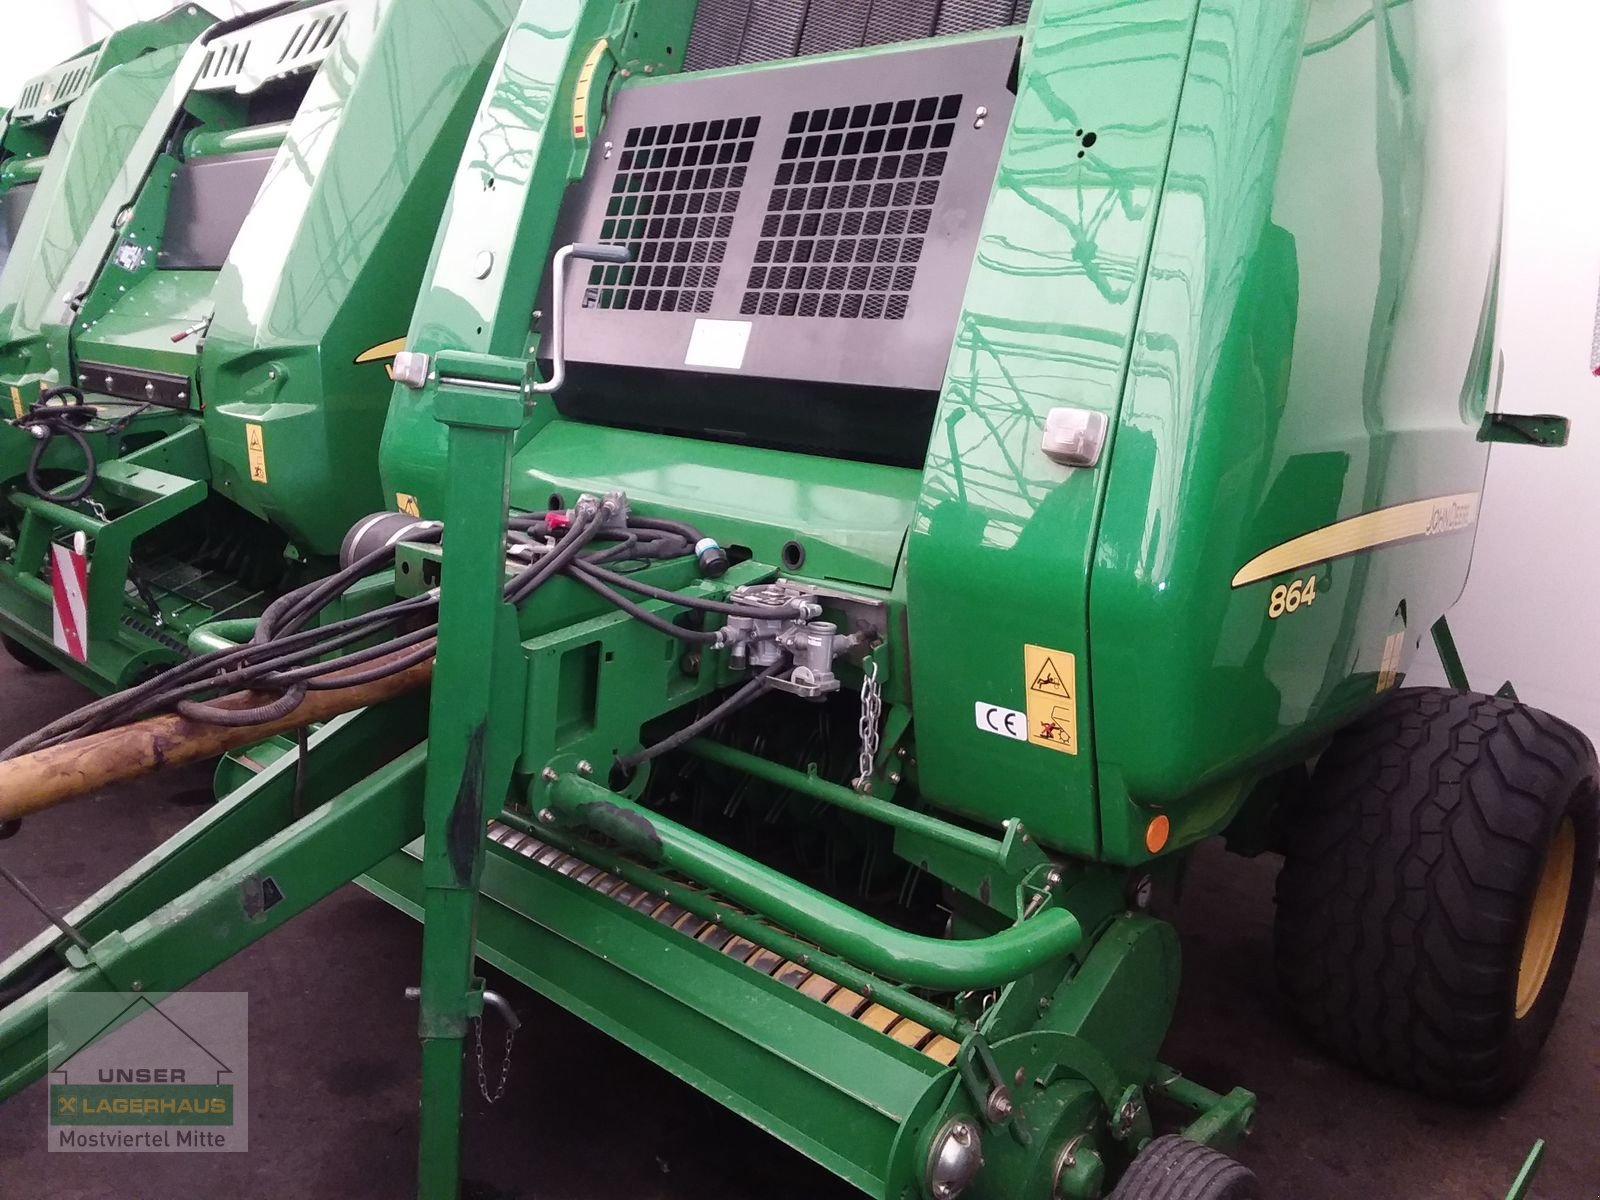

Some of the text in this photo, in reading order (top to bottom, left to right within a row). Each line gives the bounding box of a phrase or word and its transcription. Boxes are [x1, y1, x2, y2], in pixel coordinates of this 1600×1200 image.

[1426, 503, 1449, 531] JOHN
[1268, 574, 1317, 619] 864
[986, 708, 1017, 737] CE
